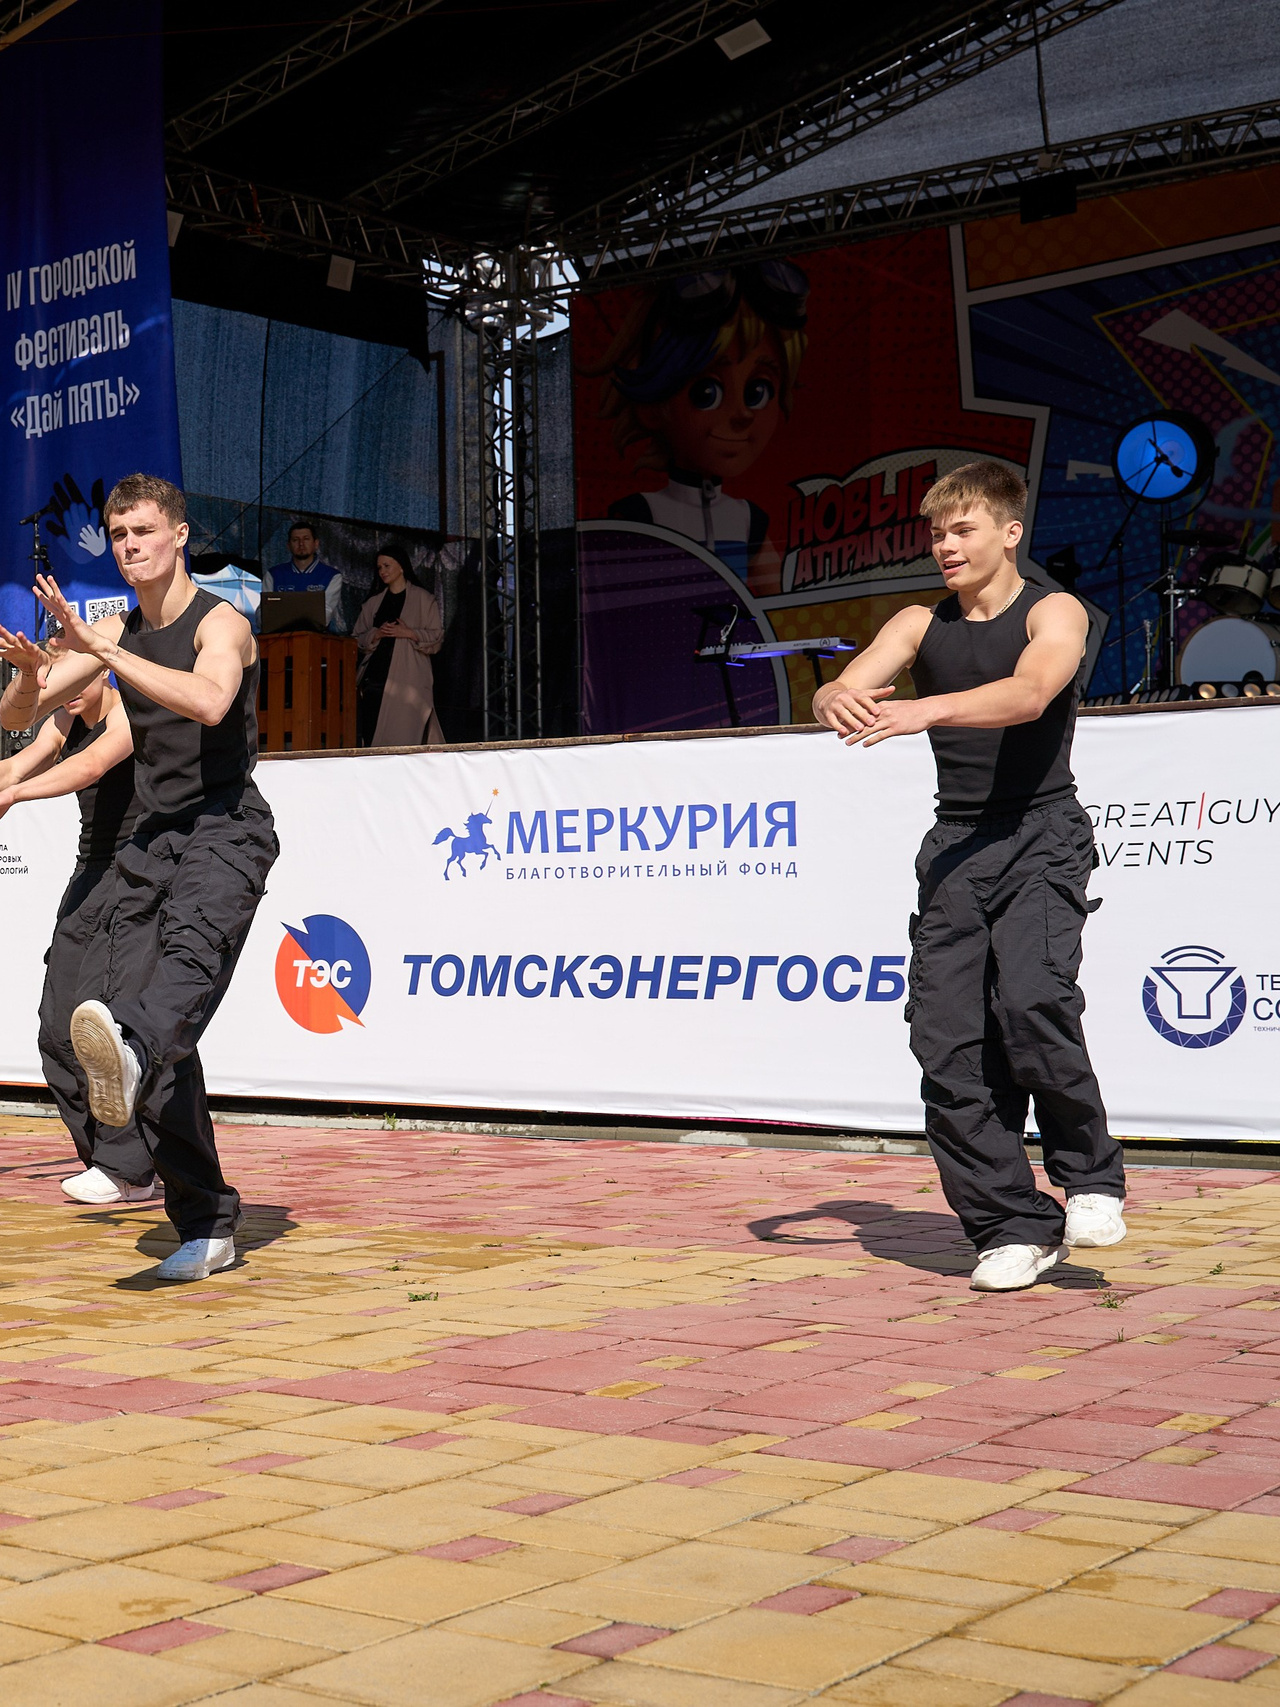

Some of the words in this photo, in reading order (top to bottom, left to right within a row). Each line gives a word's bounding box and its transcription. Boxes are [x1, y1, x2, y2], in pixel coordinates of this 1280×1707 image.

[6, 270, 22, 311] IV
[789, 459, 938, 549] НОВЫЕ
[506, 800, 798, 855] МЕРКУРИЯ
[506, 860, 728, 880] БЛАГОТВОРИТЕЛЬНЫЙ
[739, 861, 798, 879] ФОНД
[1093, 839, 1214, 867] VENTS
[292, 959, 353, 989] ТЭС
